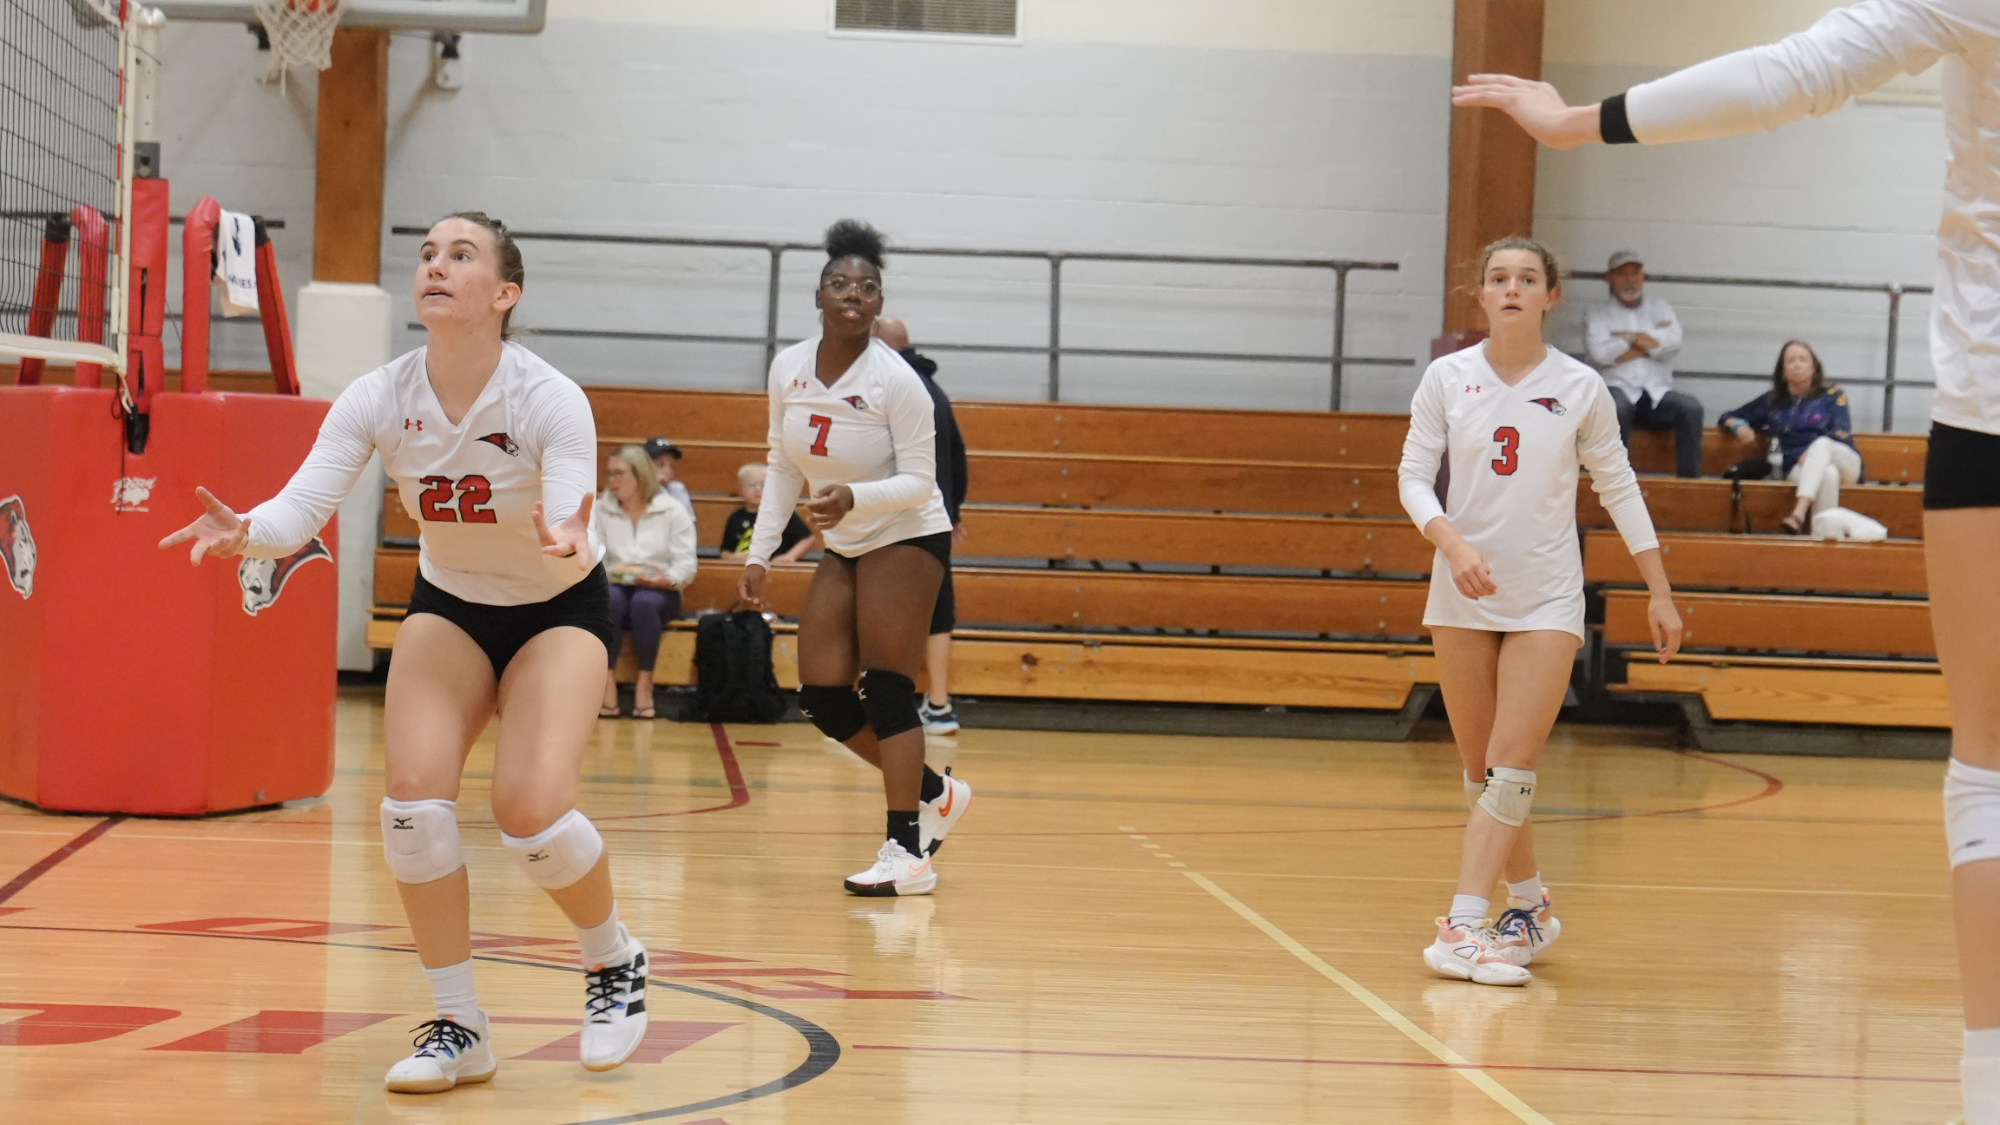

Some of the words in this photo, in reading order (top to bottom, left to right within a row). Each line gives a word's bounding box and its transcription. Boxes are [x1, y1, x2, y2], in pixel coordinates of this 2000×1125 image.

[809, 414, 832, 457] 7
[1491, 426, 1520, 476] 3
[419, 474, 498, 524] 22
